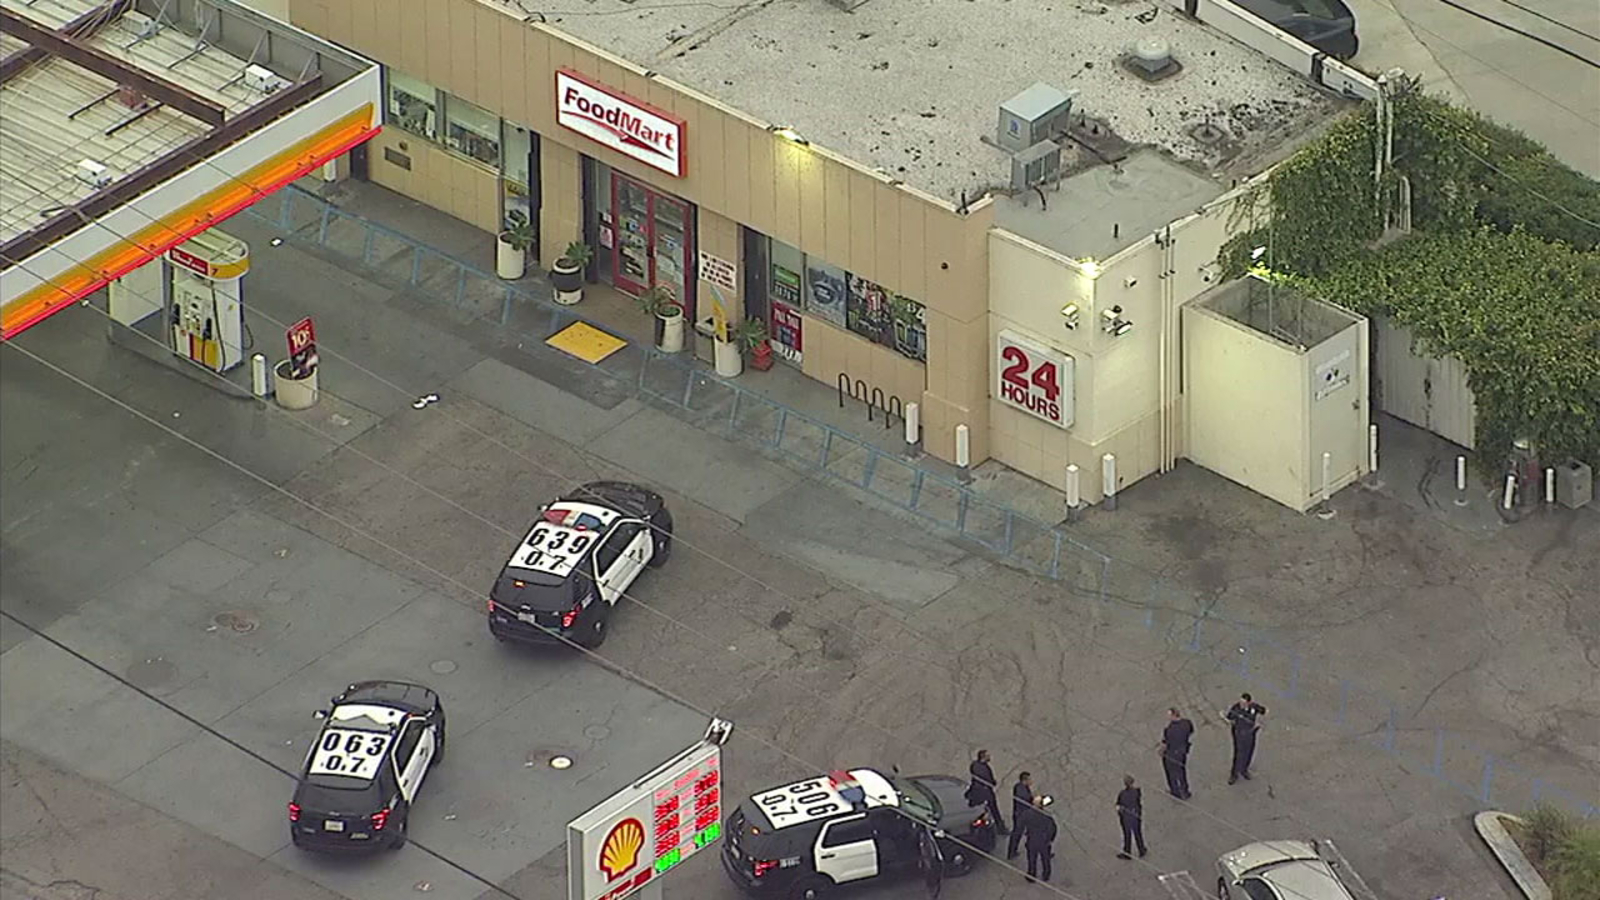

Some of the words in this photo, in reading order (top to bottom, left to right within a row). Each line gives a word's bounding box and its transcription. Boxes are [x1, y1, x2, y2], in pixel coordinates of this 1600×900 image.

[564, 86, 675, 152] FoodMart
[1002, 346, 1060, 402] 24
[1001, 380, 1060, 421] HOURS
[527, 528, 590, 554] 639
[323, 732, 386, 757] 063
[789, 781, 839, 816] 506
